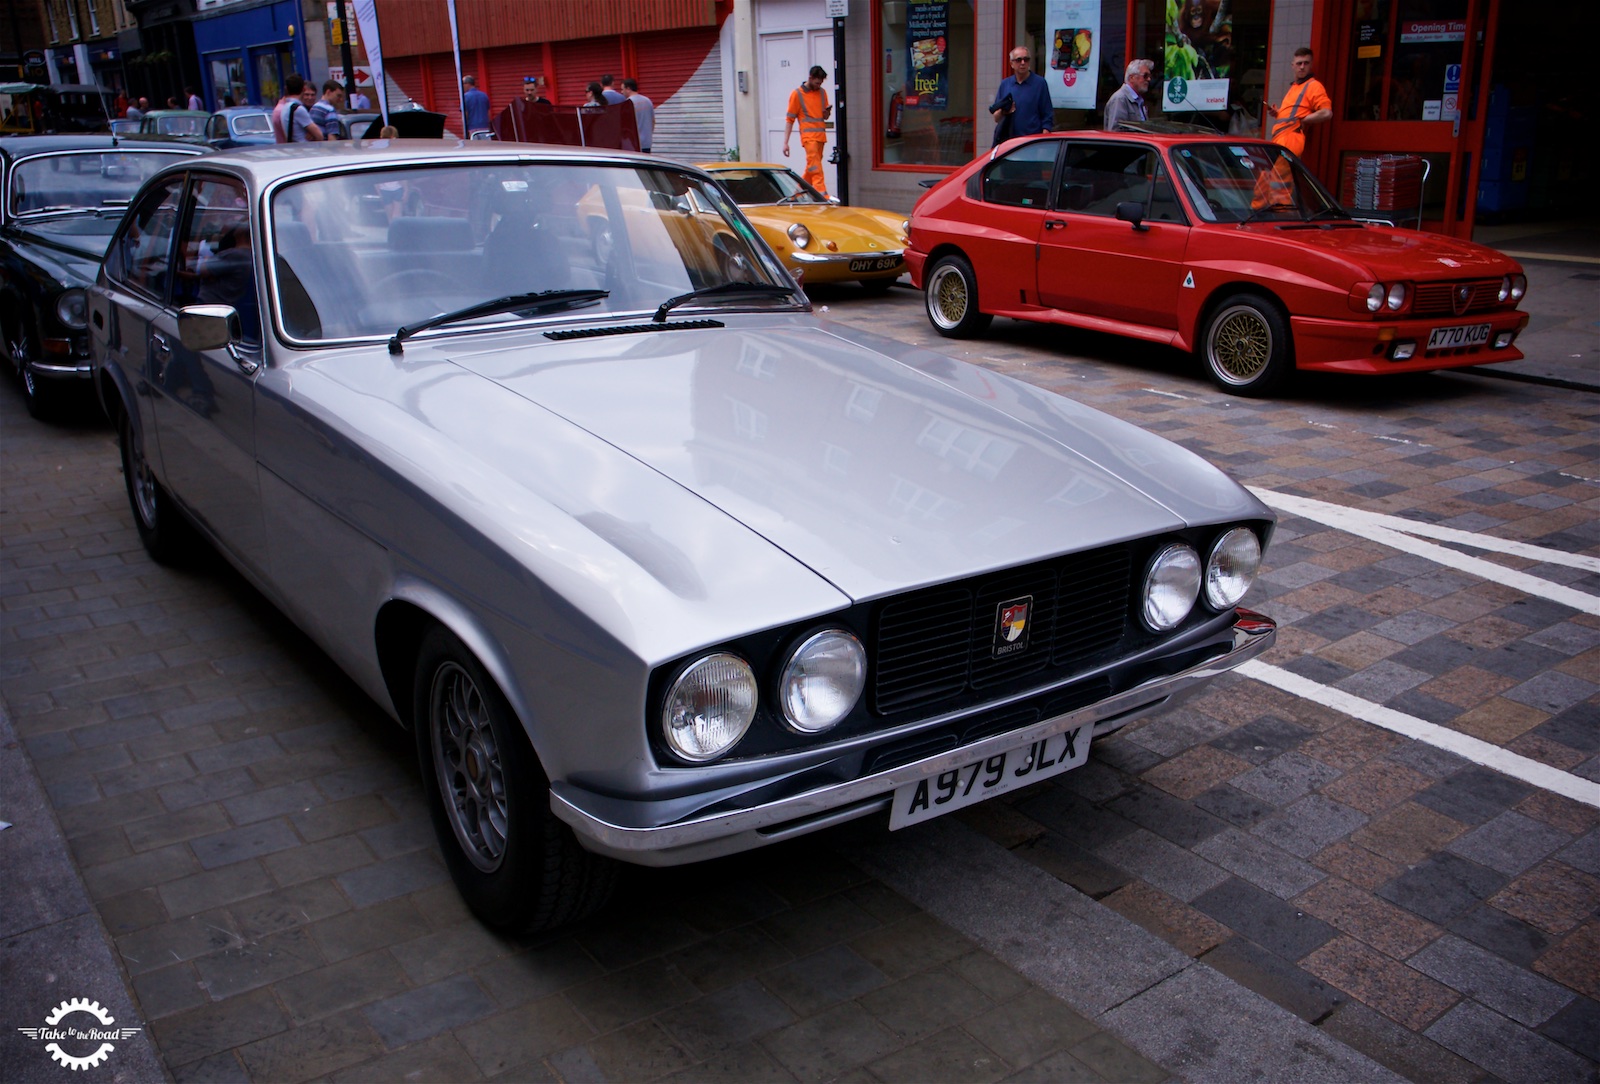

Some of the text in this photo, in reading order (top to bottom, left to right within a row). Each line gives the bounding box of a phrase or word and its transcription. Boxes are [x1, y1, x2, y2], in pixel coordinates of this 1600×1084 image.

[1411, 23, 1446, 32] Opening
[914, 72, 939, 91] free!
[851, 257, 898, 271] DHY 69K
[1429, 325, 1489, 345] A770 KUG
[997, 641, 1024, 655] BRISTOL
[908, 727, 1081, 815] A979 JLX
